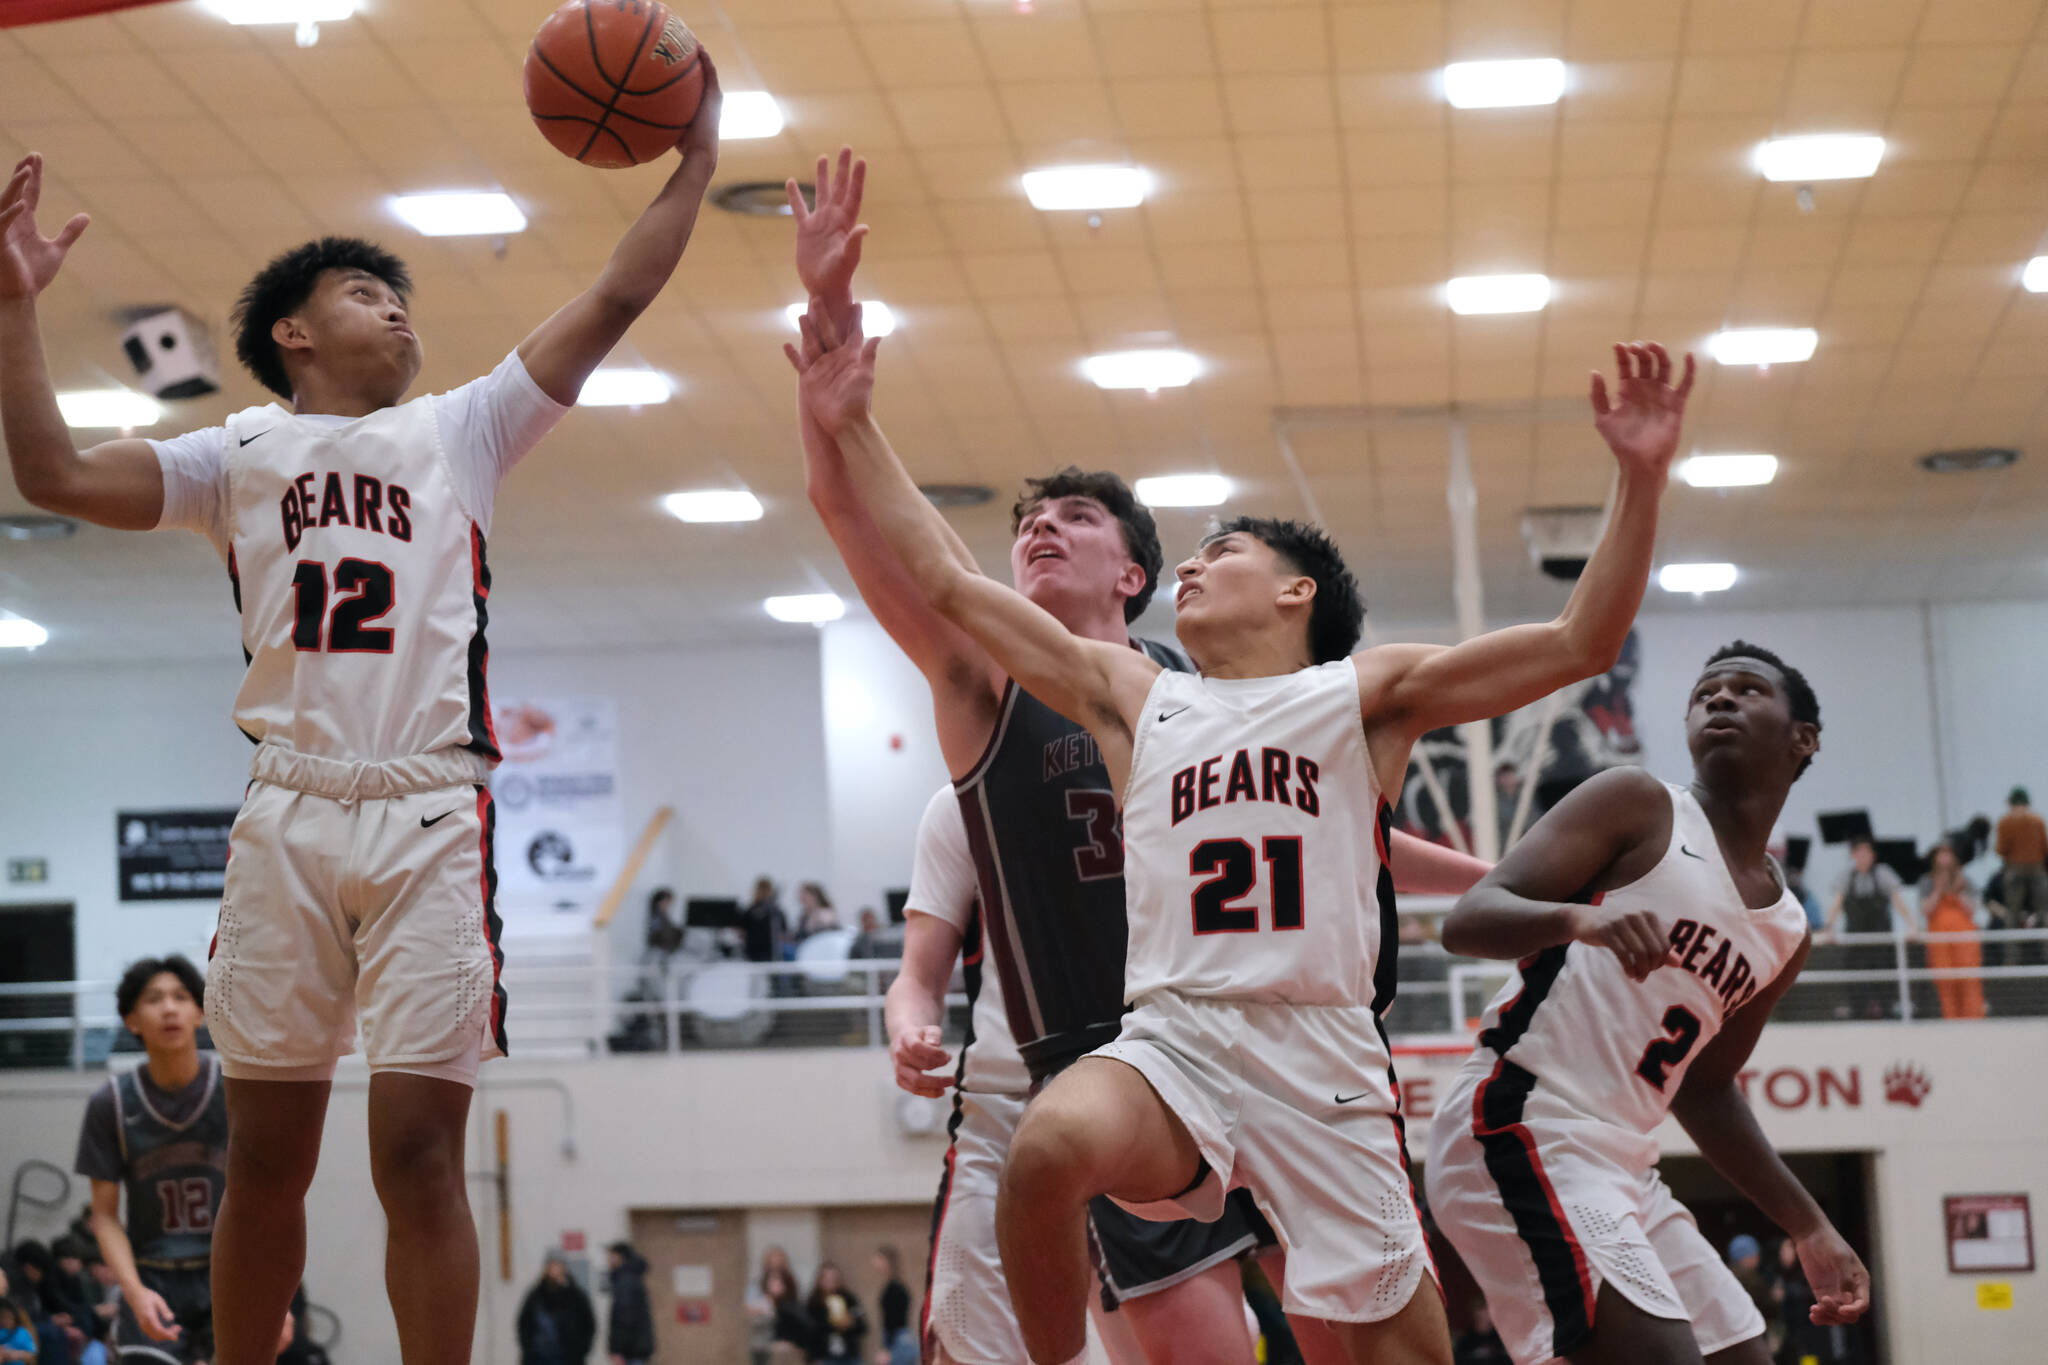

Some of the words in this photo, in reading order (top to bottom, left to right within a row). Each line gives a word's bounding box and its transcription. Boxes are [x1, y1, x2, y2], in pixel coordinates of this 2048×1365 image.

[281, 472, 412, 555] BEARS
[291, 557, 396, 654] 12
[1042, 730, 1104, 783] KET
[1171, 747, 1320, 828] BEARS
[1189, 835, 1305, 936] 21
[1635, 1004, 1701, 1094] 2
[158, 1177, 213, 1234] 12
